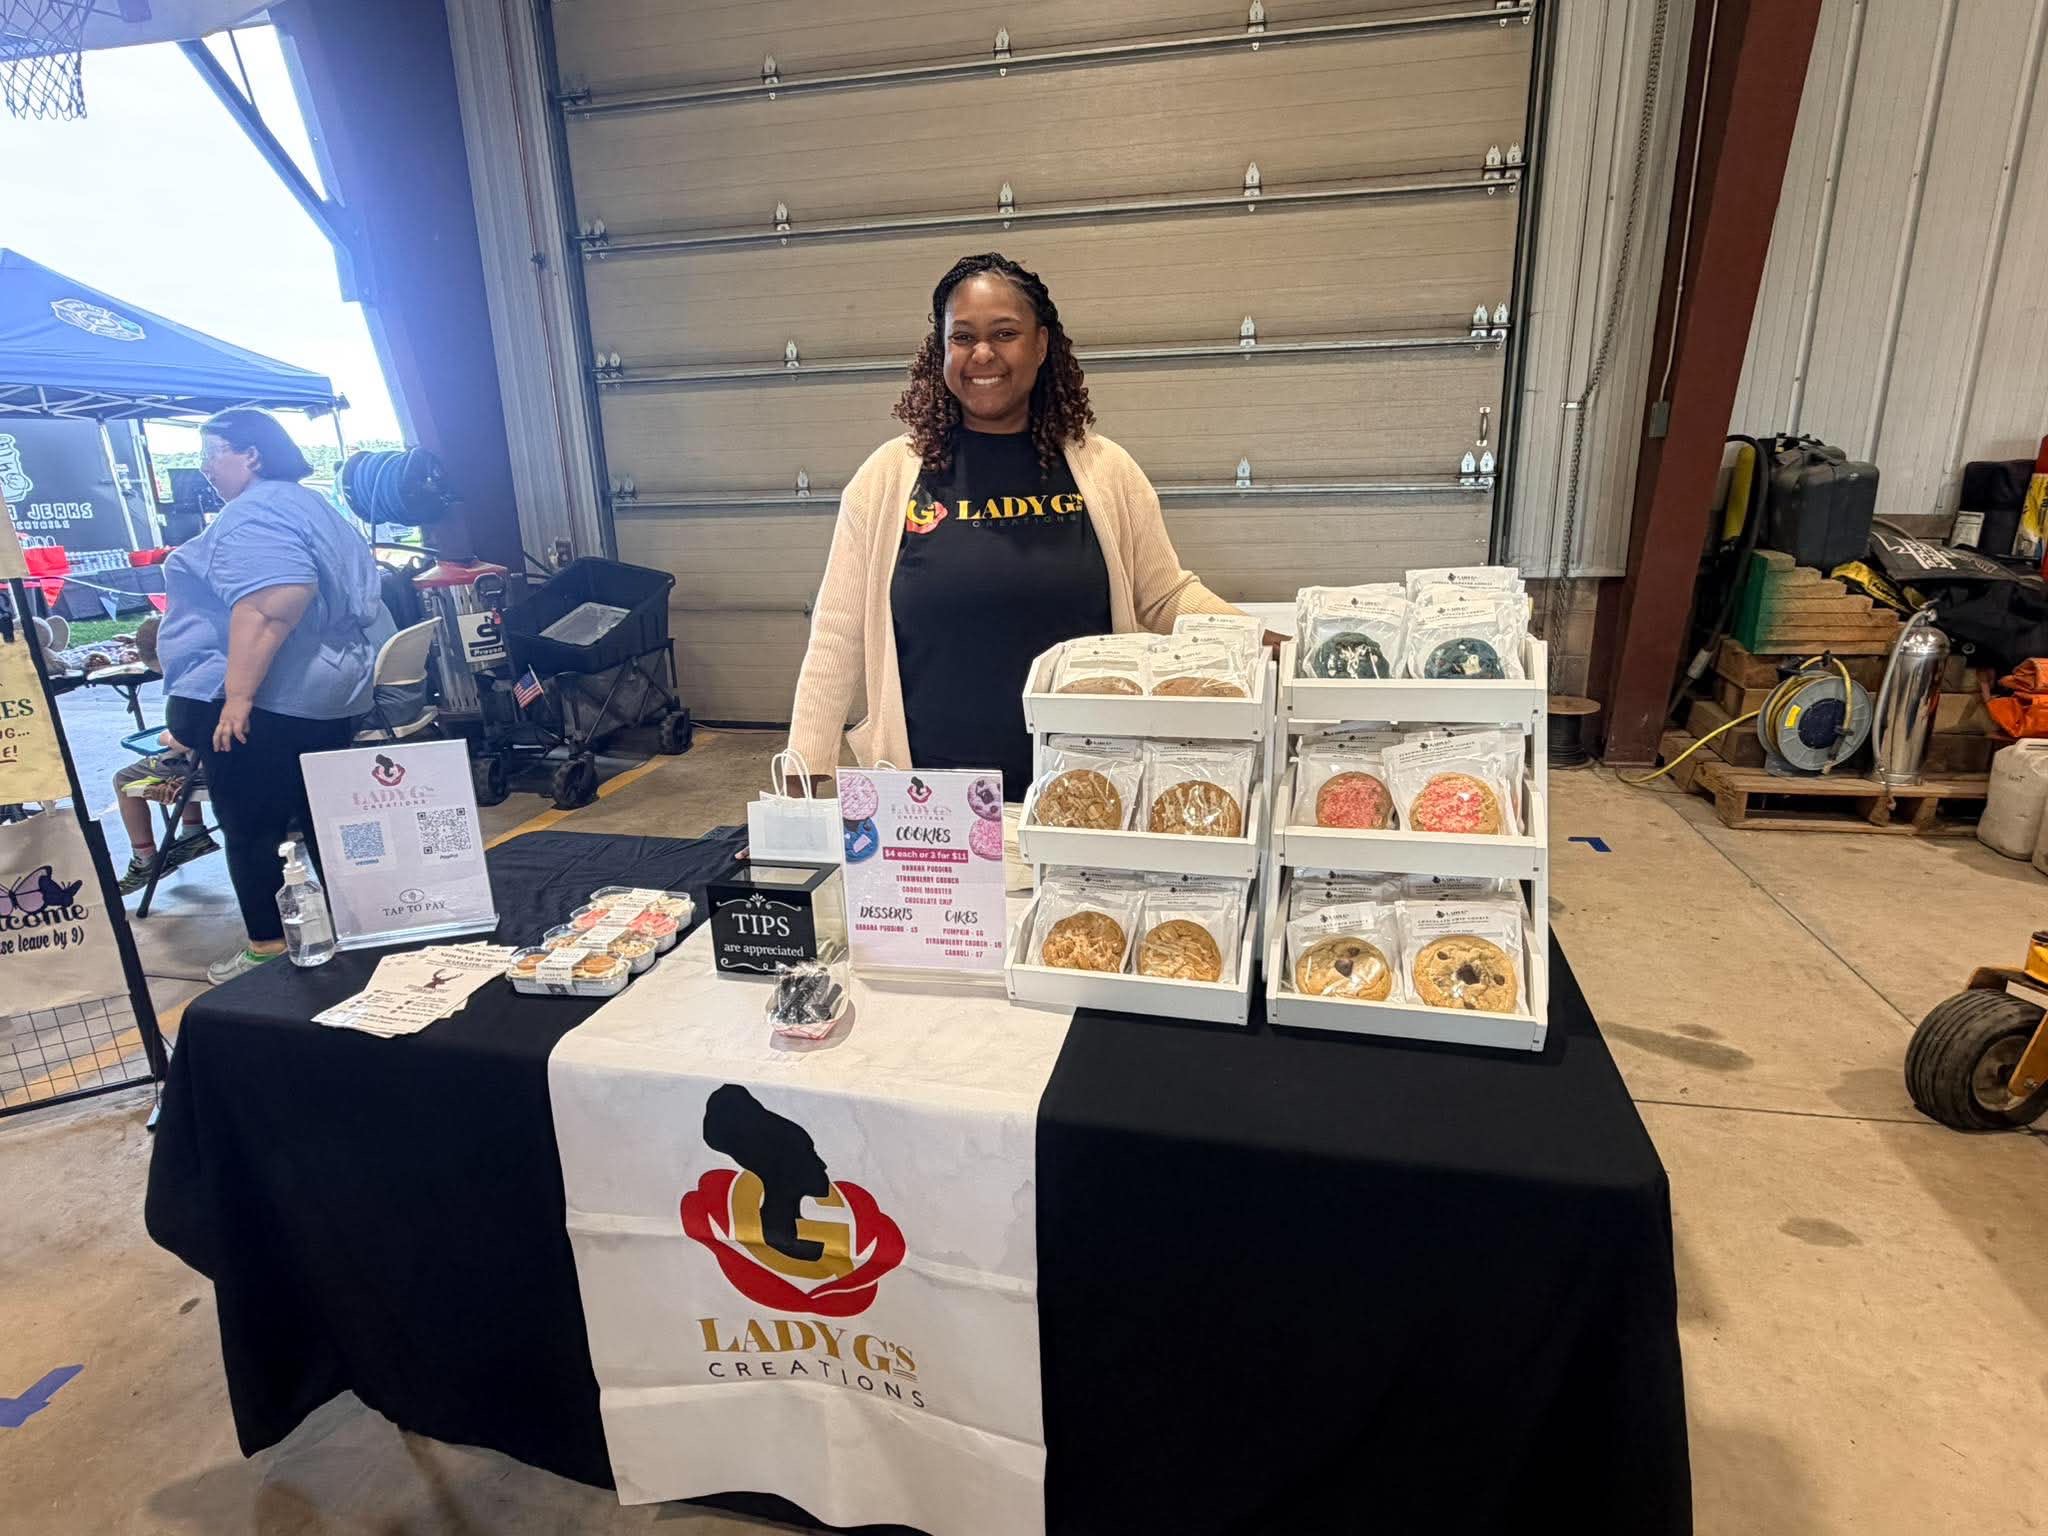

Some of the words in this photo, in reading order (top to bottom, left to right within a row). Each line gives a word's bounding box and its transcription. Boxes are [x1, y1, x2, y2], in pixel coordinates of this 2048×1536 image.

[27, 502, 94, 520] JERKS
[956, 495, 1048, 520] LADY
[0, 698, 34, 719] ES
[896, 826, 951, 844] COOKIES
[884, 849, 895, 858] $4
[897, 850, 917, 858] each
[937, 851, 950, 859] for
[951, 852, 966, 861] $11
[901, 864, 925, 872] BANANA
[927, 865, 952, 873] PUDDING
[896, 875, 934, 884] STRAWBERRY
[936, 876, 960, 884] CRUNCH
[902, 886, 922, 894] COOKIE
[924, 886, 952, 895] MONSTER
[904, 896, 937, 905] CHOCOLATE
[383, 906, 404, 918] TAP
[407, 904, 422, 914] TO
[425, 901, 448, 912] PAY
[860, 906, 913, 921] DESSERTS
[945, 910, 979, 925] CAKES
[732, 913, 790, 937] TIPS
[18, 934, 50, 953] leave
[53, 929, 68, 950] by
[71, 925, 85, 946] 9)
[925, 937, 962, 946] STRAWBERRY
[724, 944, 741, 952] are
[743, 945, 804, 957] appreciated
[696, 1317, 848, 1360] LADY
[708, 1359, 926, 1408] CREATIONS
